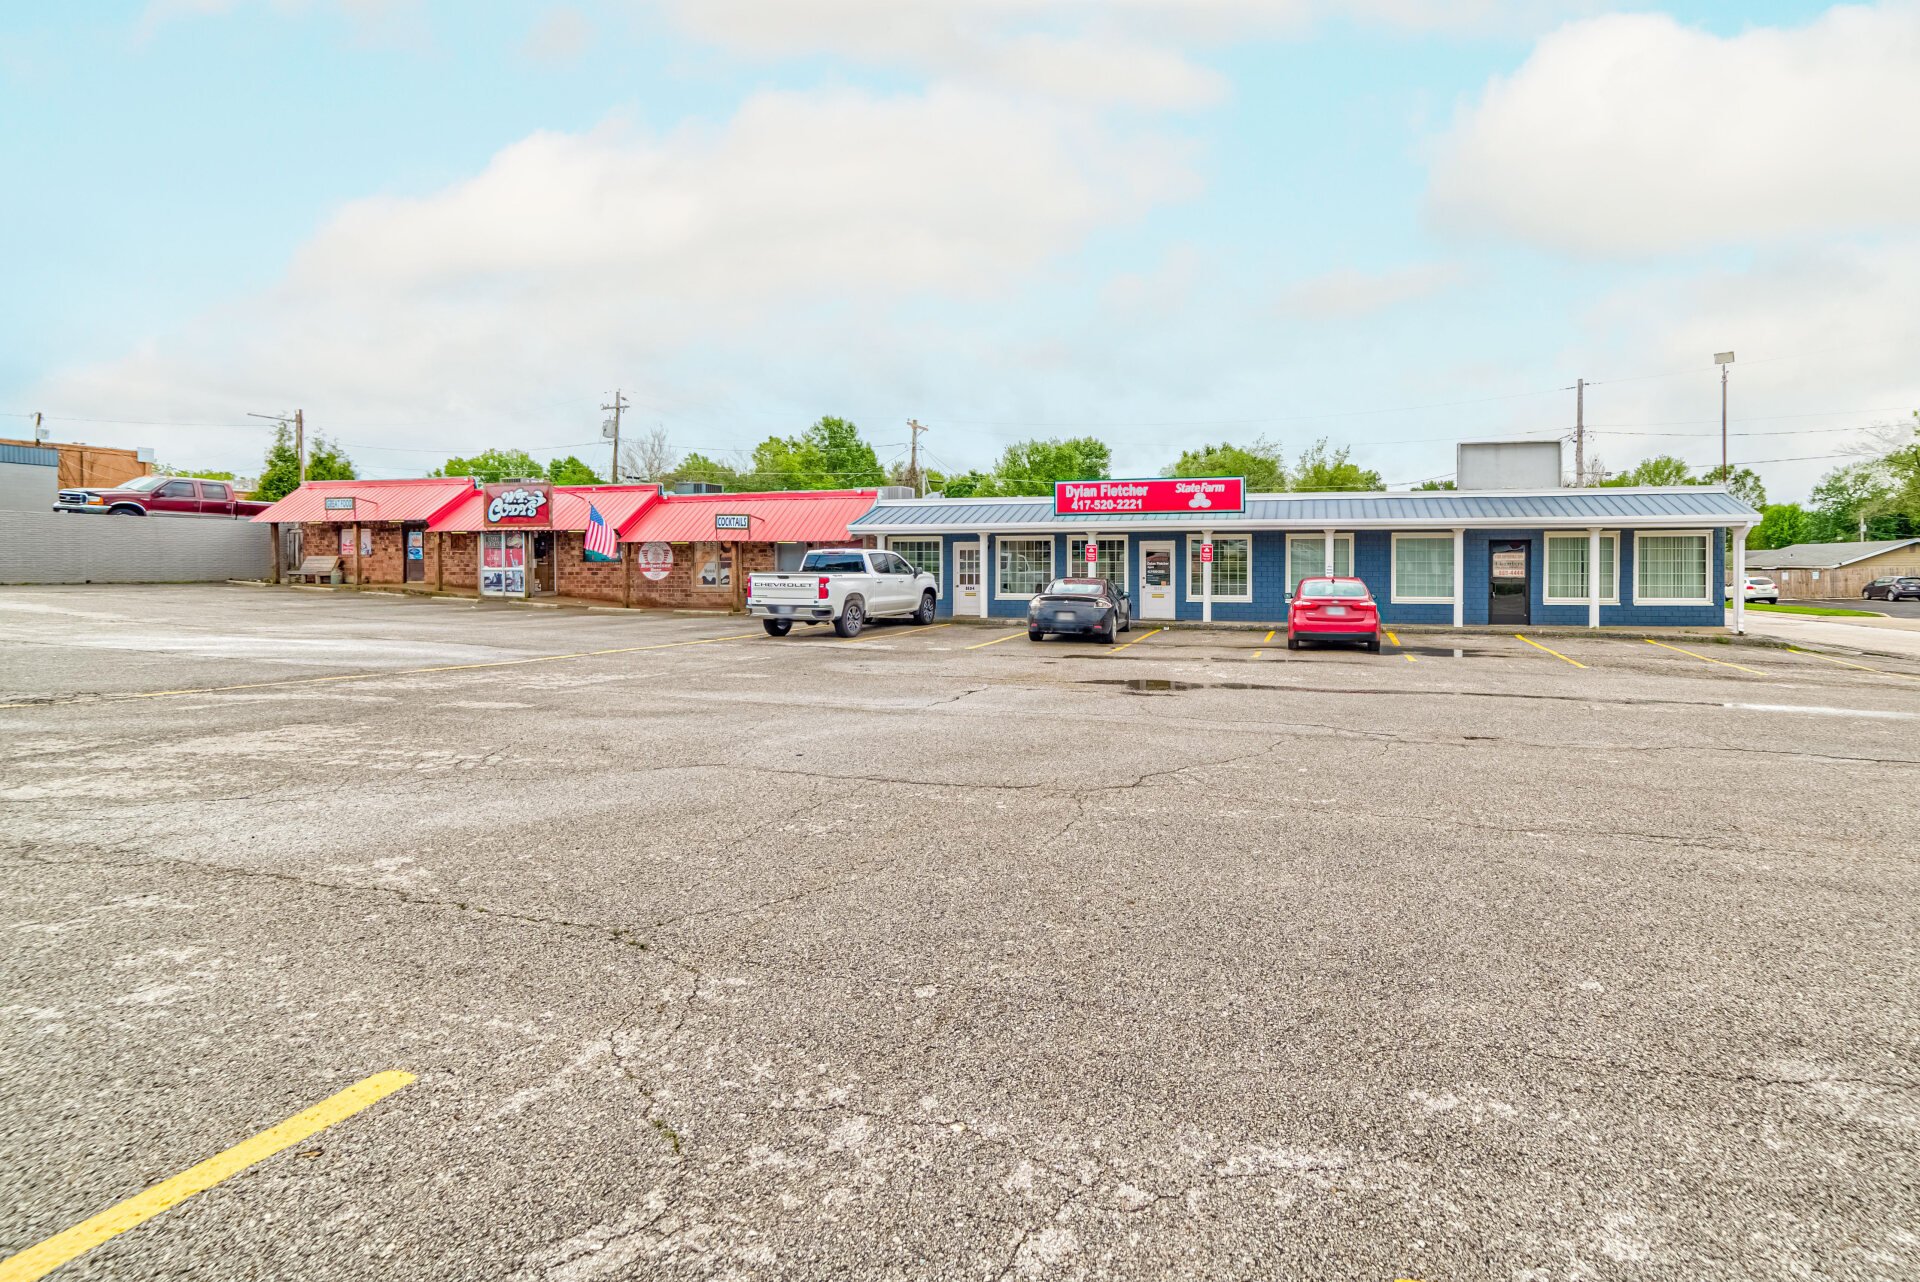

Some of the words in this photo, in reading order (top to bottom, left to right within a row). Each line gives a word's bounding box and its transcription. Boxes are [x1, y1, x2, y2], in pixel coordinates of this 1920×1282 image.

[1065, 485, 1097, 501] Dylan
[1100, 484, 1149, 497] Fletcher
[1071, 499, 1142, 510] 417-520-2221
[717, 517, 747, 527] COCKTAILS
